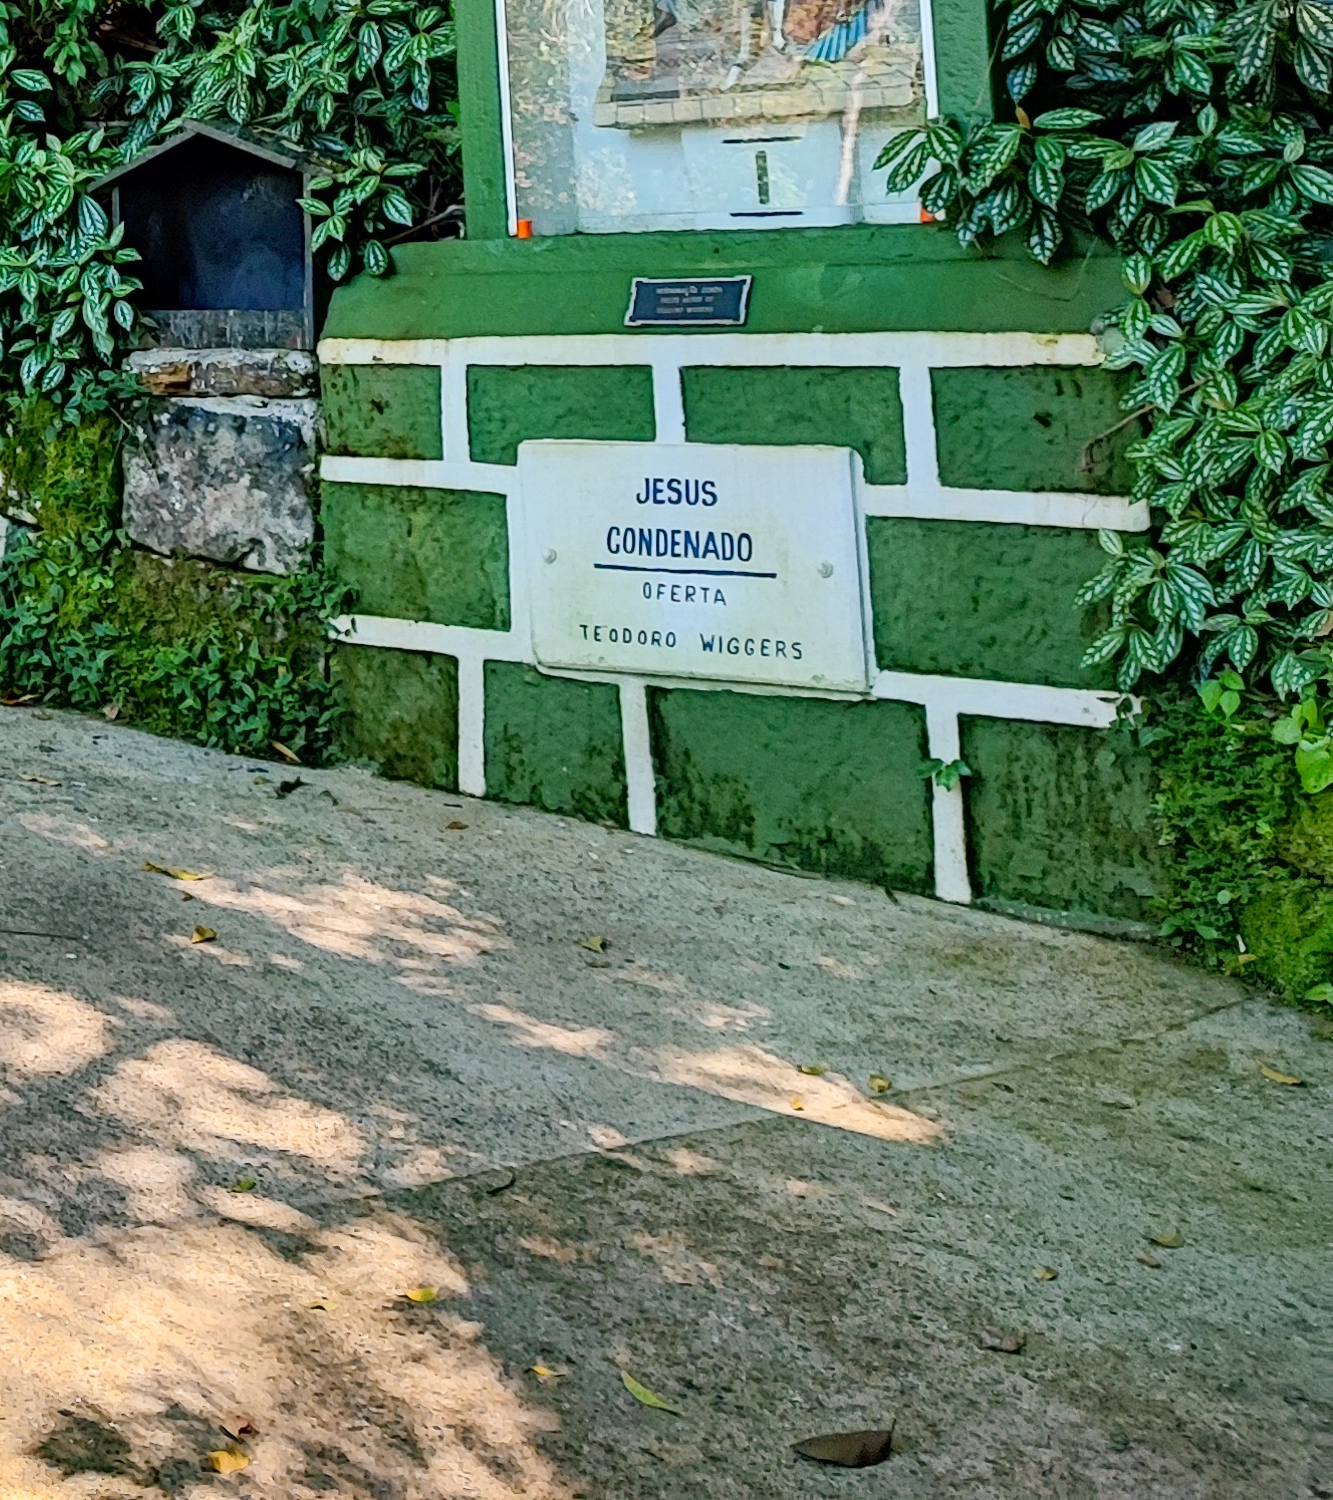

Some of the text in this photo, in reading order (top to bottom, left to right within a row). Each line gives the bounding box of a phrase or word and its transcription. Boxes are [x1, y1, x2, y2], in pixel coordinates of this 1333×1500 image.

[635, 477, 718, 507] JESUS
[606, 526, 753, 563] CONDENADO
[642, 582, 727, 606] OFERTA
[579, 623, 803, 660] TEODORO WIGGERS
